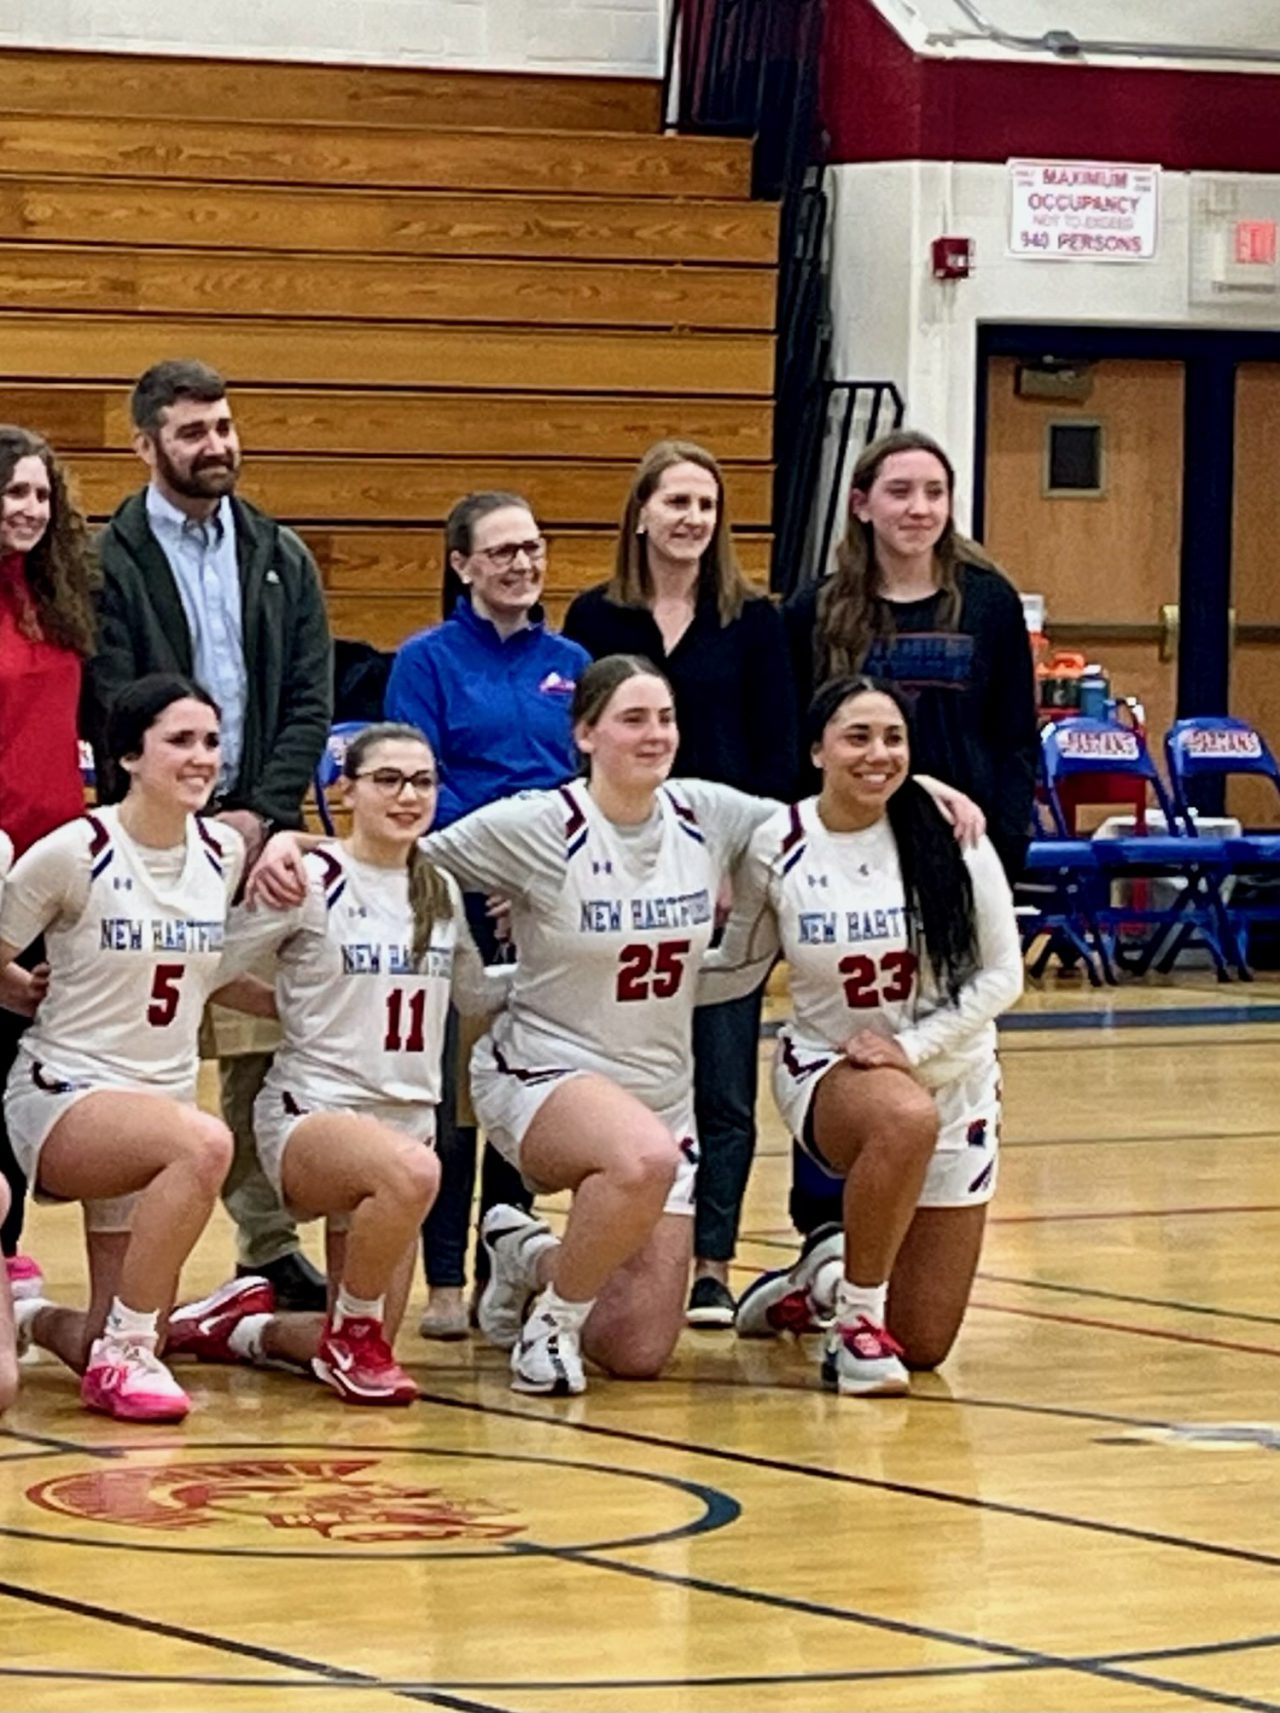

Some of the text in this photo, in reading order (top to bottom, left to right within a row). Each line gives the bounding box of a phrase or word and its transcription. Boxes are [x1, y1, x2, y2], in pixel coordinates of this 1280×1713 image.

[1042, 168, 1128, 188] MAXIMUM
[1028, 193, 1140, 214] OCCUPANCY
[1033, 215, 1060, 227] NOT
[1065, 216, 1081, 228] TO
[1058, 233, 1141, 253] PERSONS
[580, 900, 622, 932] NEW
[798, 911, 836, 945] NEW
[100, 917, 142, 950] NEW
[341, 944, 381, 975] NEW
[616, 939, 691, 1002] 25
[147, 964, 185, 1026] 5
[838, 951, 918, 1008] 23
[384, 988, 426, 1051] 11
